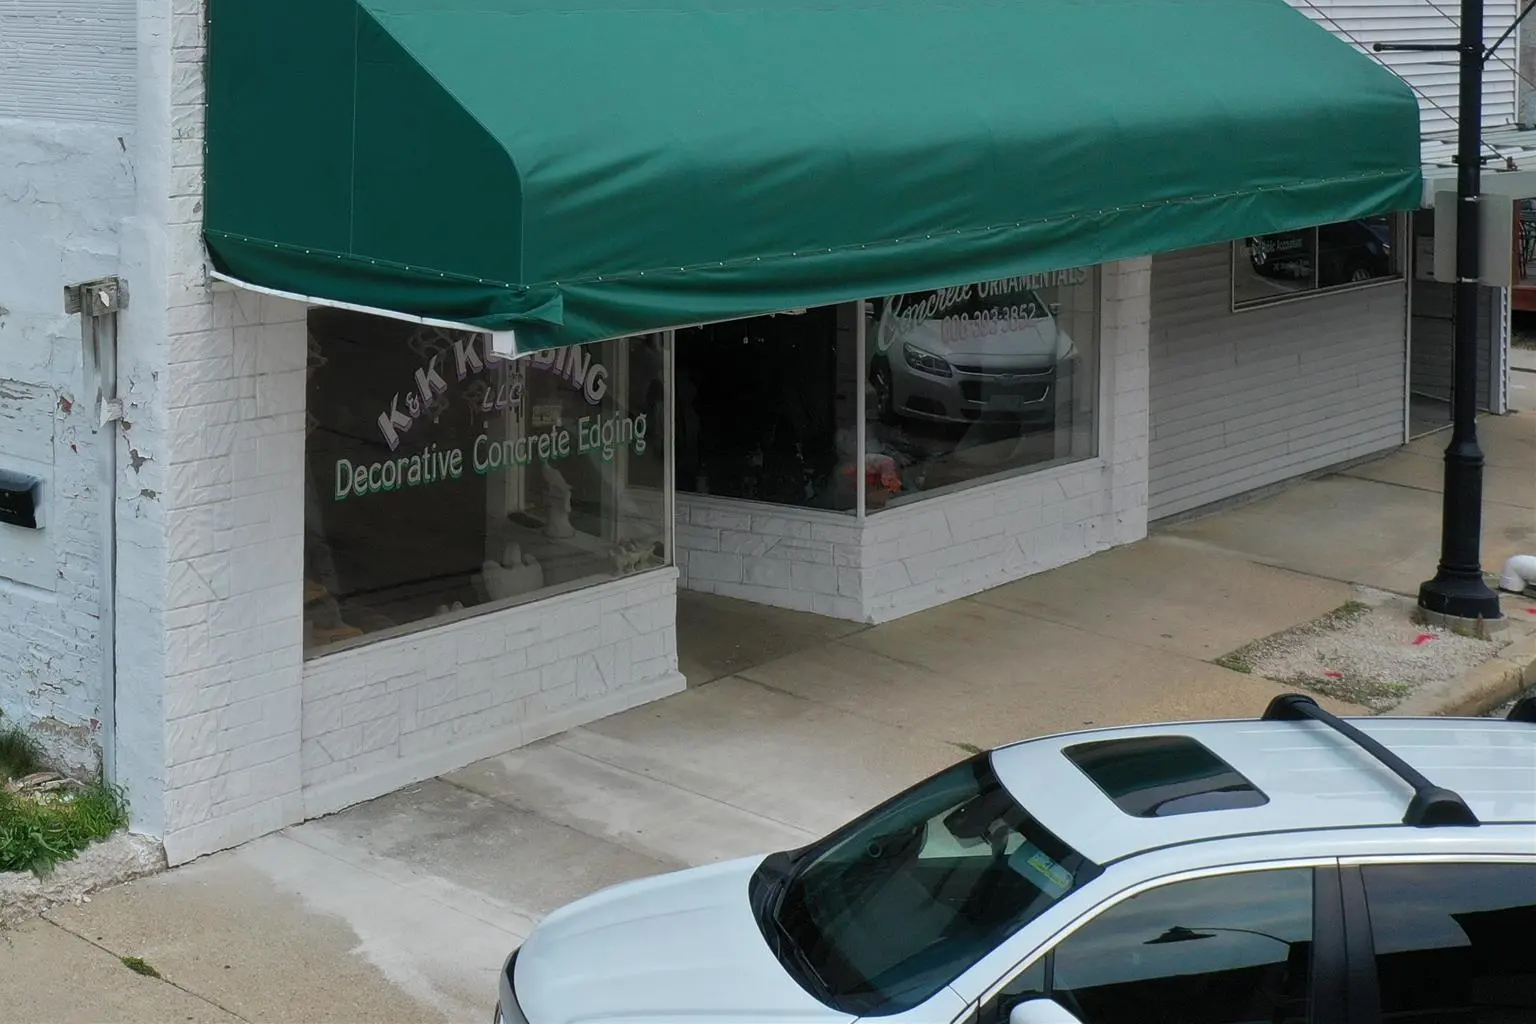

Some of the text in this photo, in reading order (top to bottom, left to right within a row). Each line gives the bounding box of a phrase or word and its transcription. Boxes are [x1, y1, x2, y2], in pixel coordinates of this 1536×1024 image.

[377, 333, 609, 452] K&K KUING
[481, 382, 523, 412] LLC
[334, 412, 648, 501] Decorative Concrete Edging
